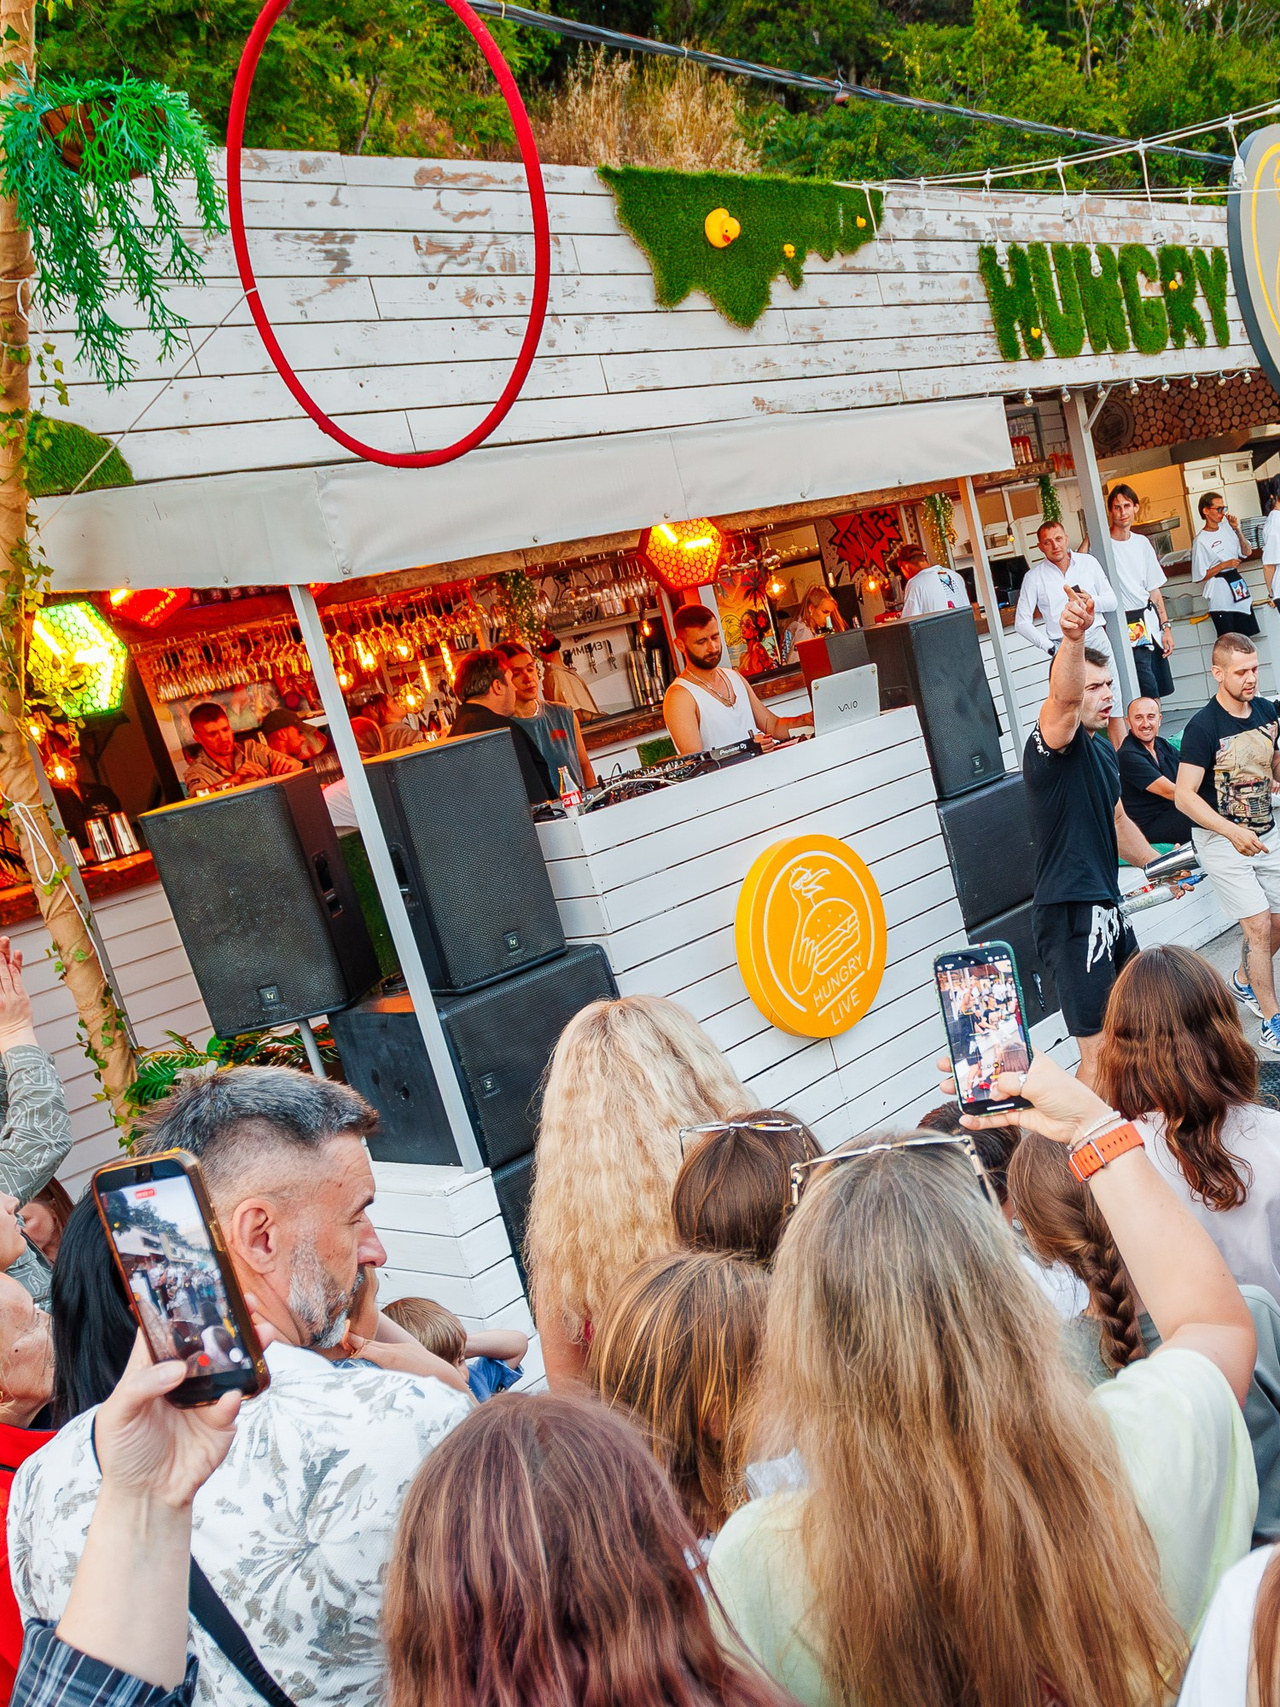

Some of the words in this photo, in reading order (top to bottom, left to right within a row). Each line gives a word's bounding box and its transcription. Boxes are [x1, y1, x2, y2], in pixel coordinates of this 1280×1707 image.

[979, 241, 1230, 362] HUNGRY
[837, 700, 858, 712] VAIO
[812, 950, 863, 1008] HUNGRY
[830, 987, 861, 1026] LIVE
